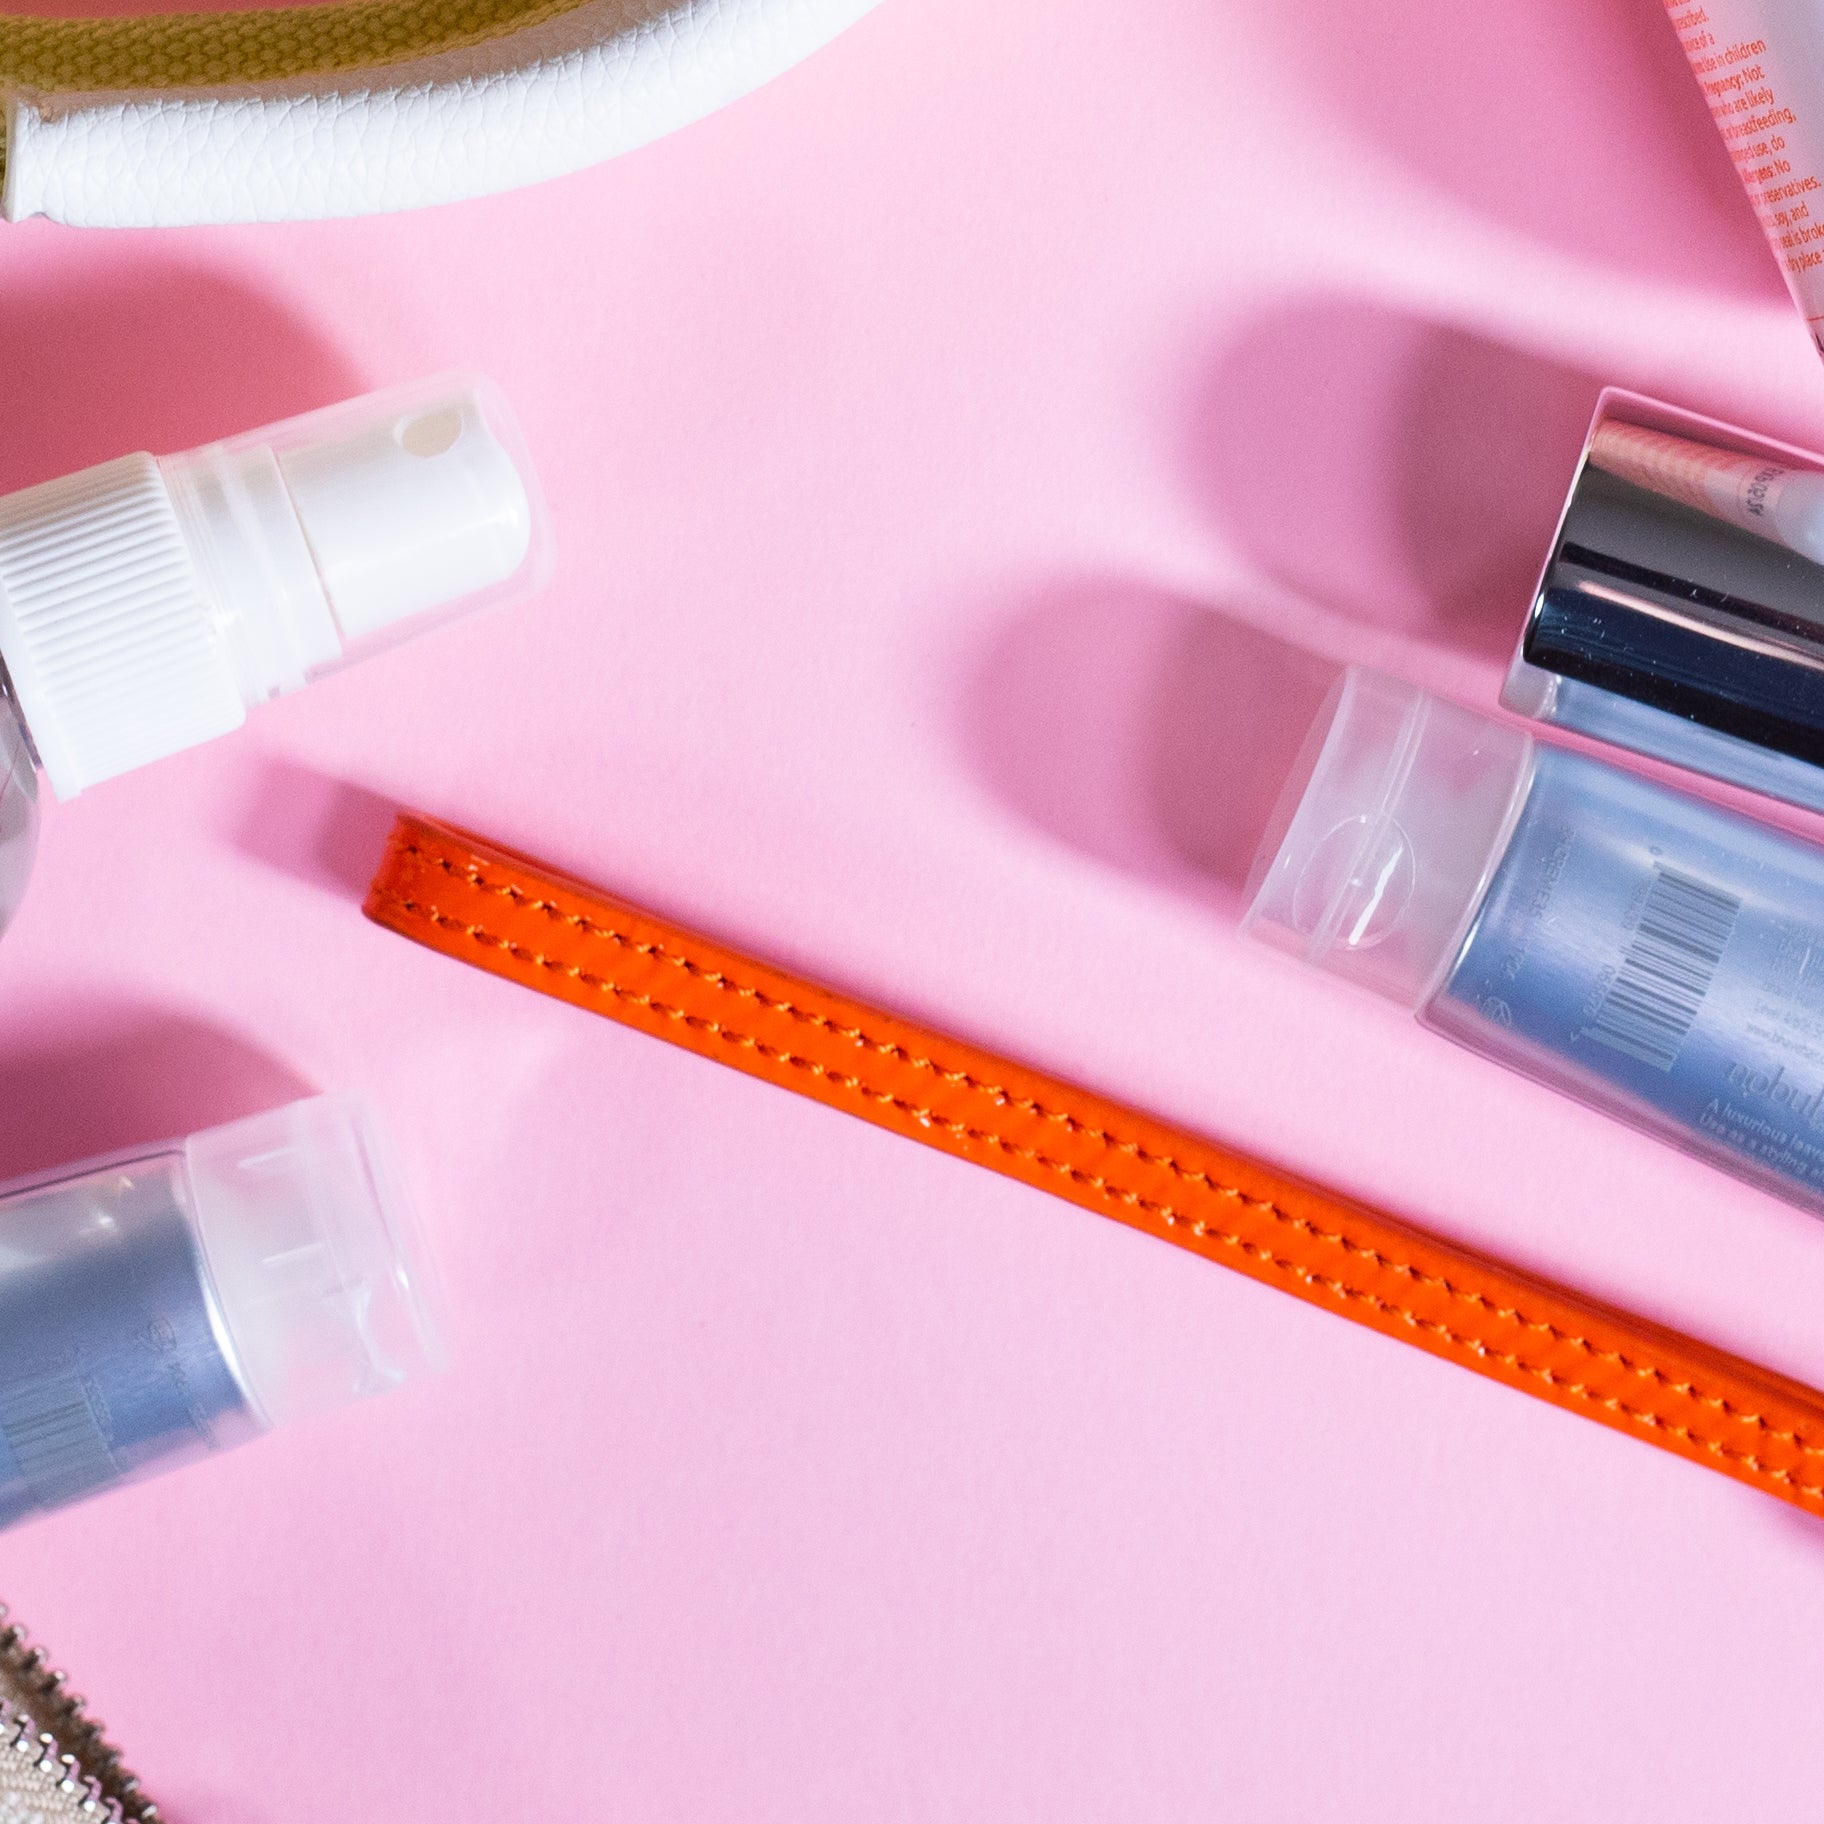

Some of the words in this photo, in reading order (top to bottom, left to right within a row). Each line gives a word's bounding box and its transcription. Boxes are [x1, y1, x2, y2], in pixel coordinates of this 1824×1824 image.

[1721, 34, 1768, 66] children
[1741, 63, 1765, 85] Not
[1743, 82, 1776, 112] likely
[1768, 131, 1787, 153] do
[1772, 156, 1791, 176] No
[1787, 199, 1810, 222] and
